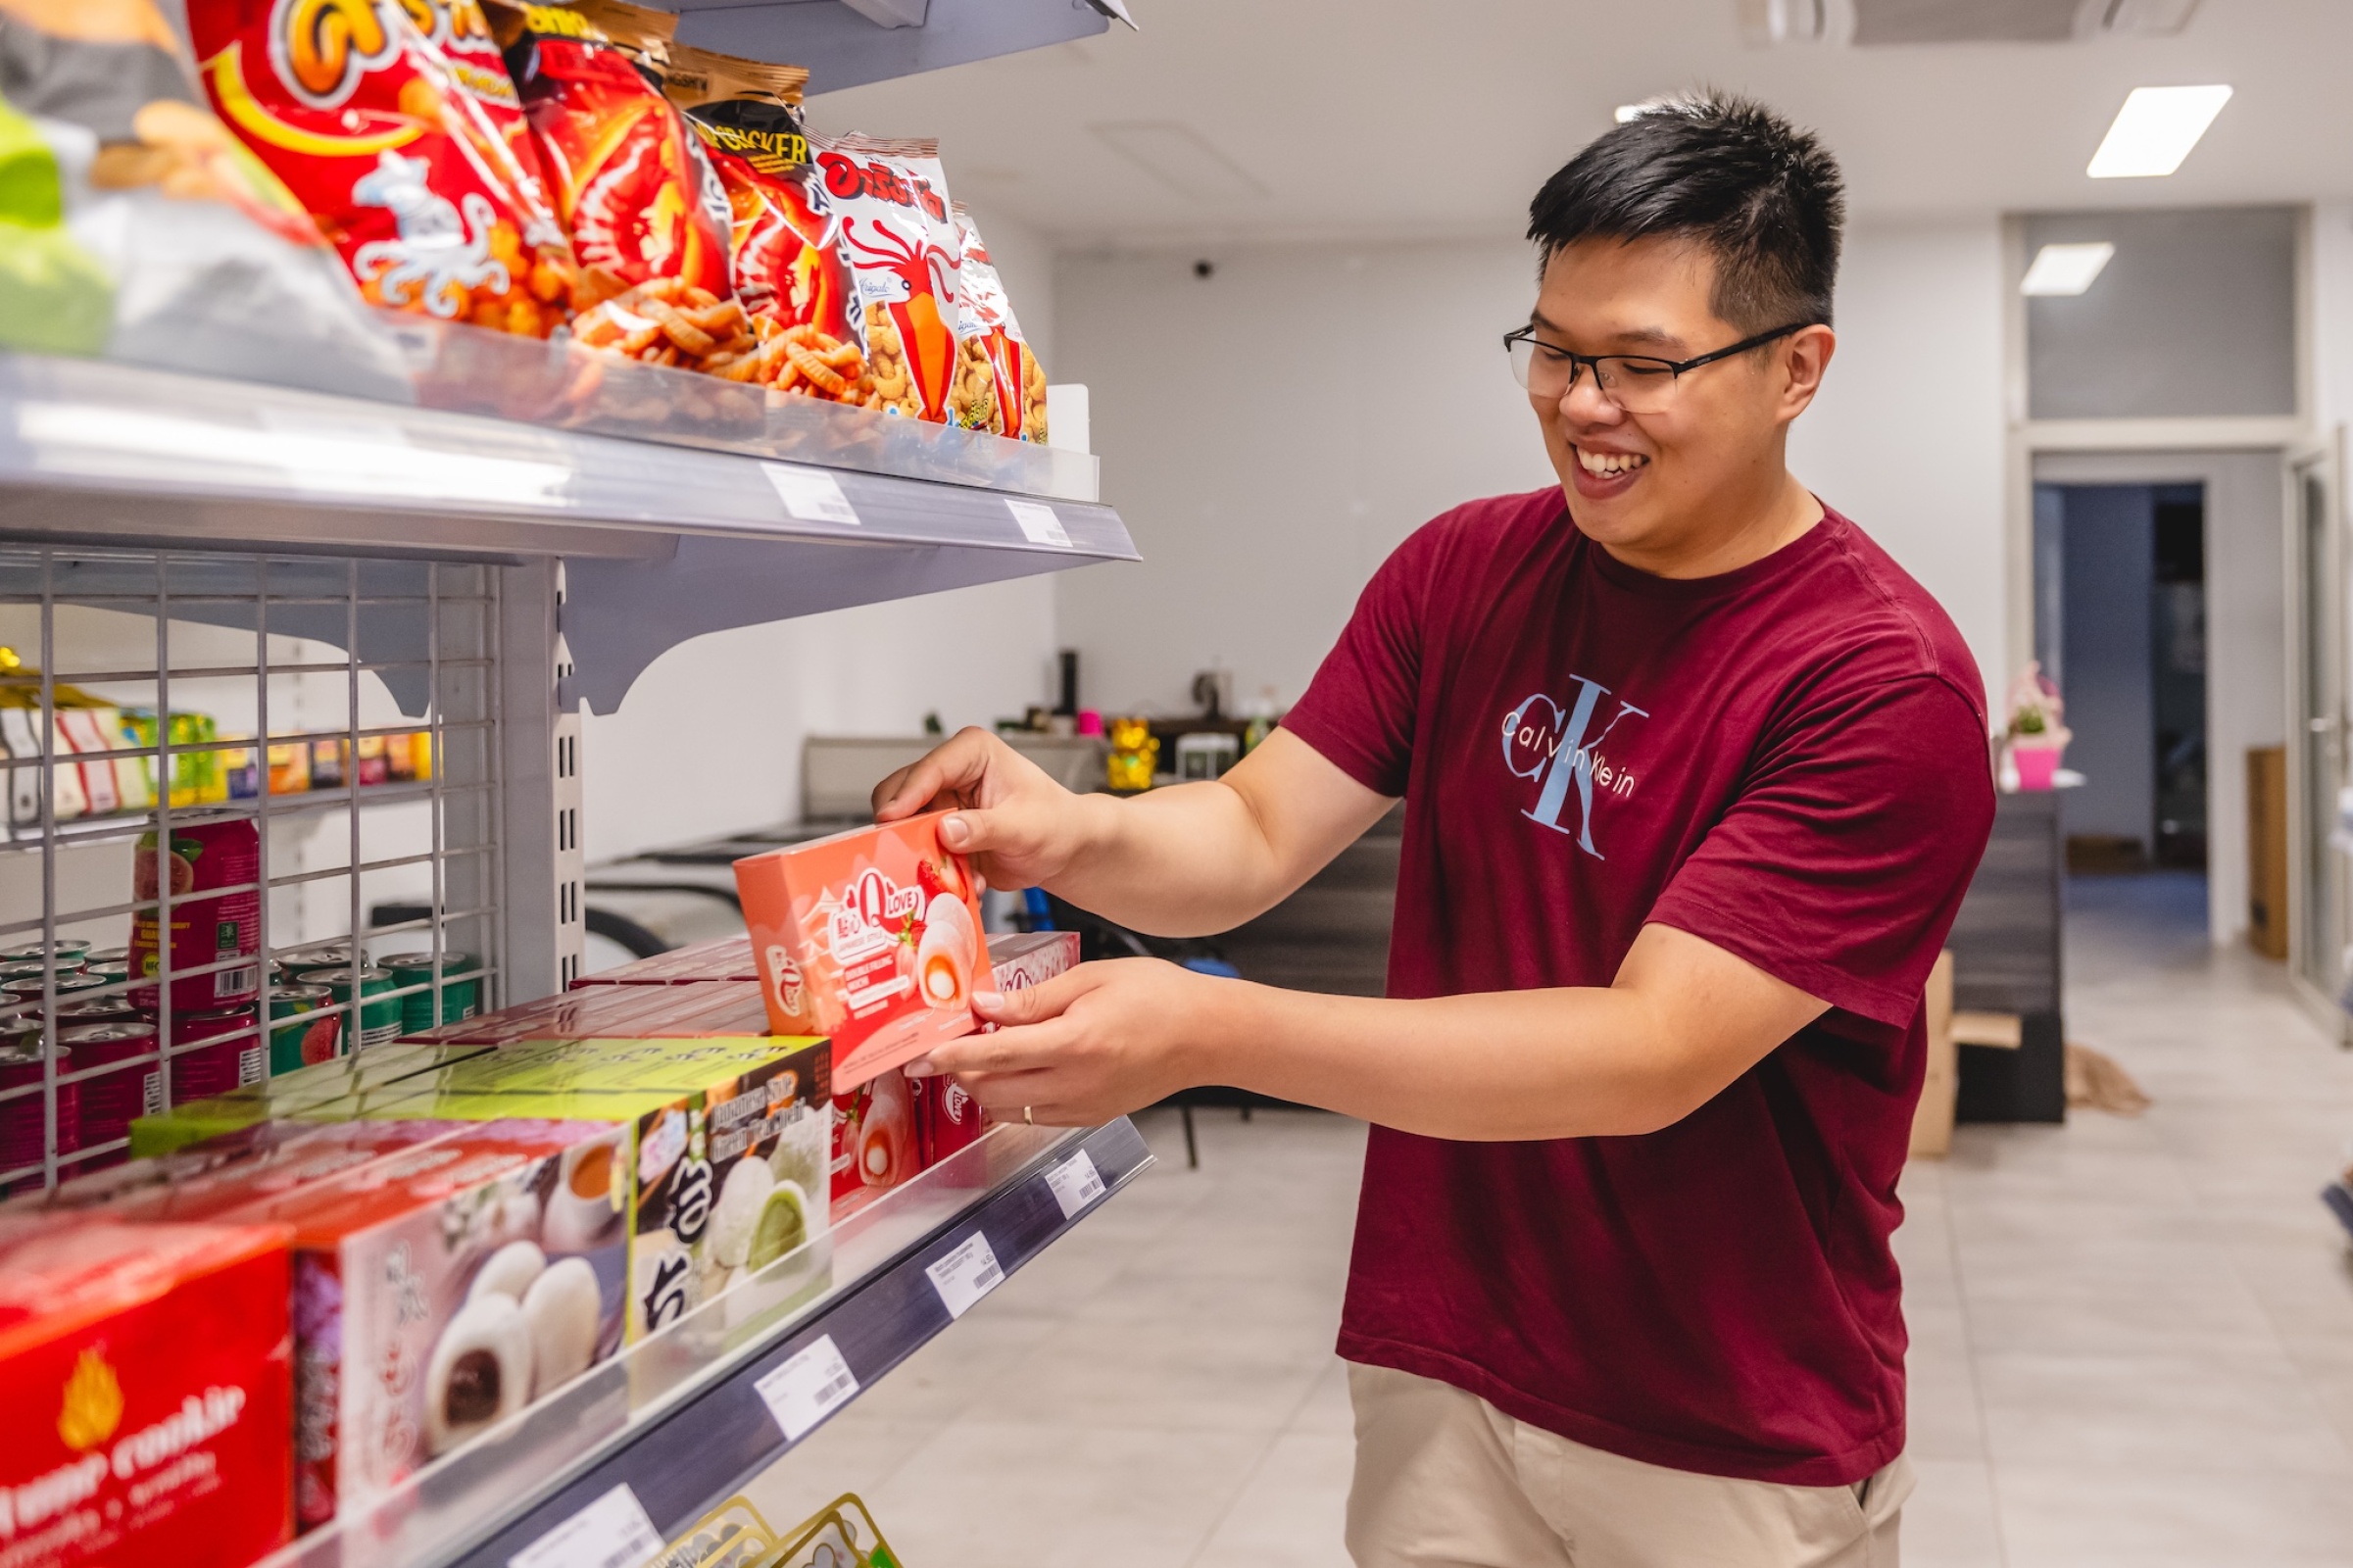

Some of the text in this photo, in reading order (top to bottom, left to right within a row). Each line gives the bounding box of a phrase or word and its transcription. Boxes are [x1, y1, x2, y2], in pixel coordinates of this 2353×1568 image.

[1501, 711, 1636, 798] Calvin Klein
[888, 891, 912, 914] LOVE
[954, 1092, 963, 1119] LOVE
